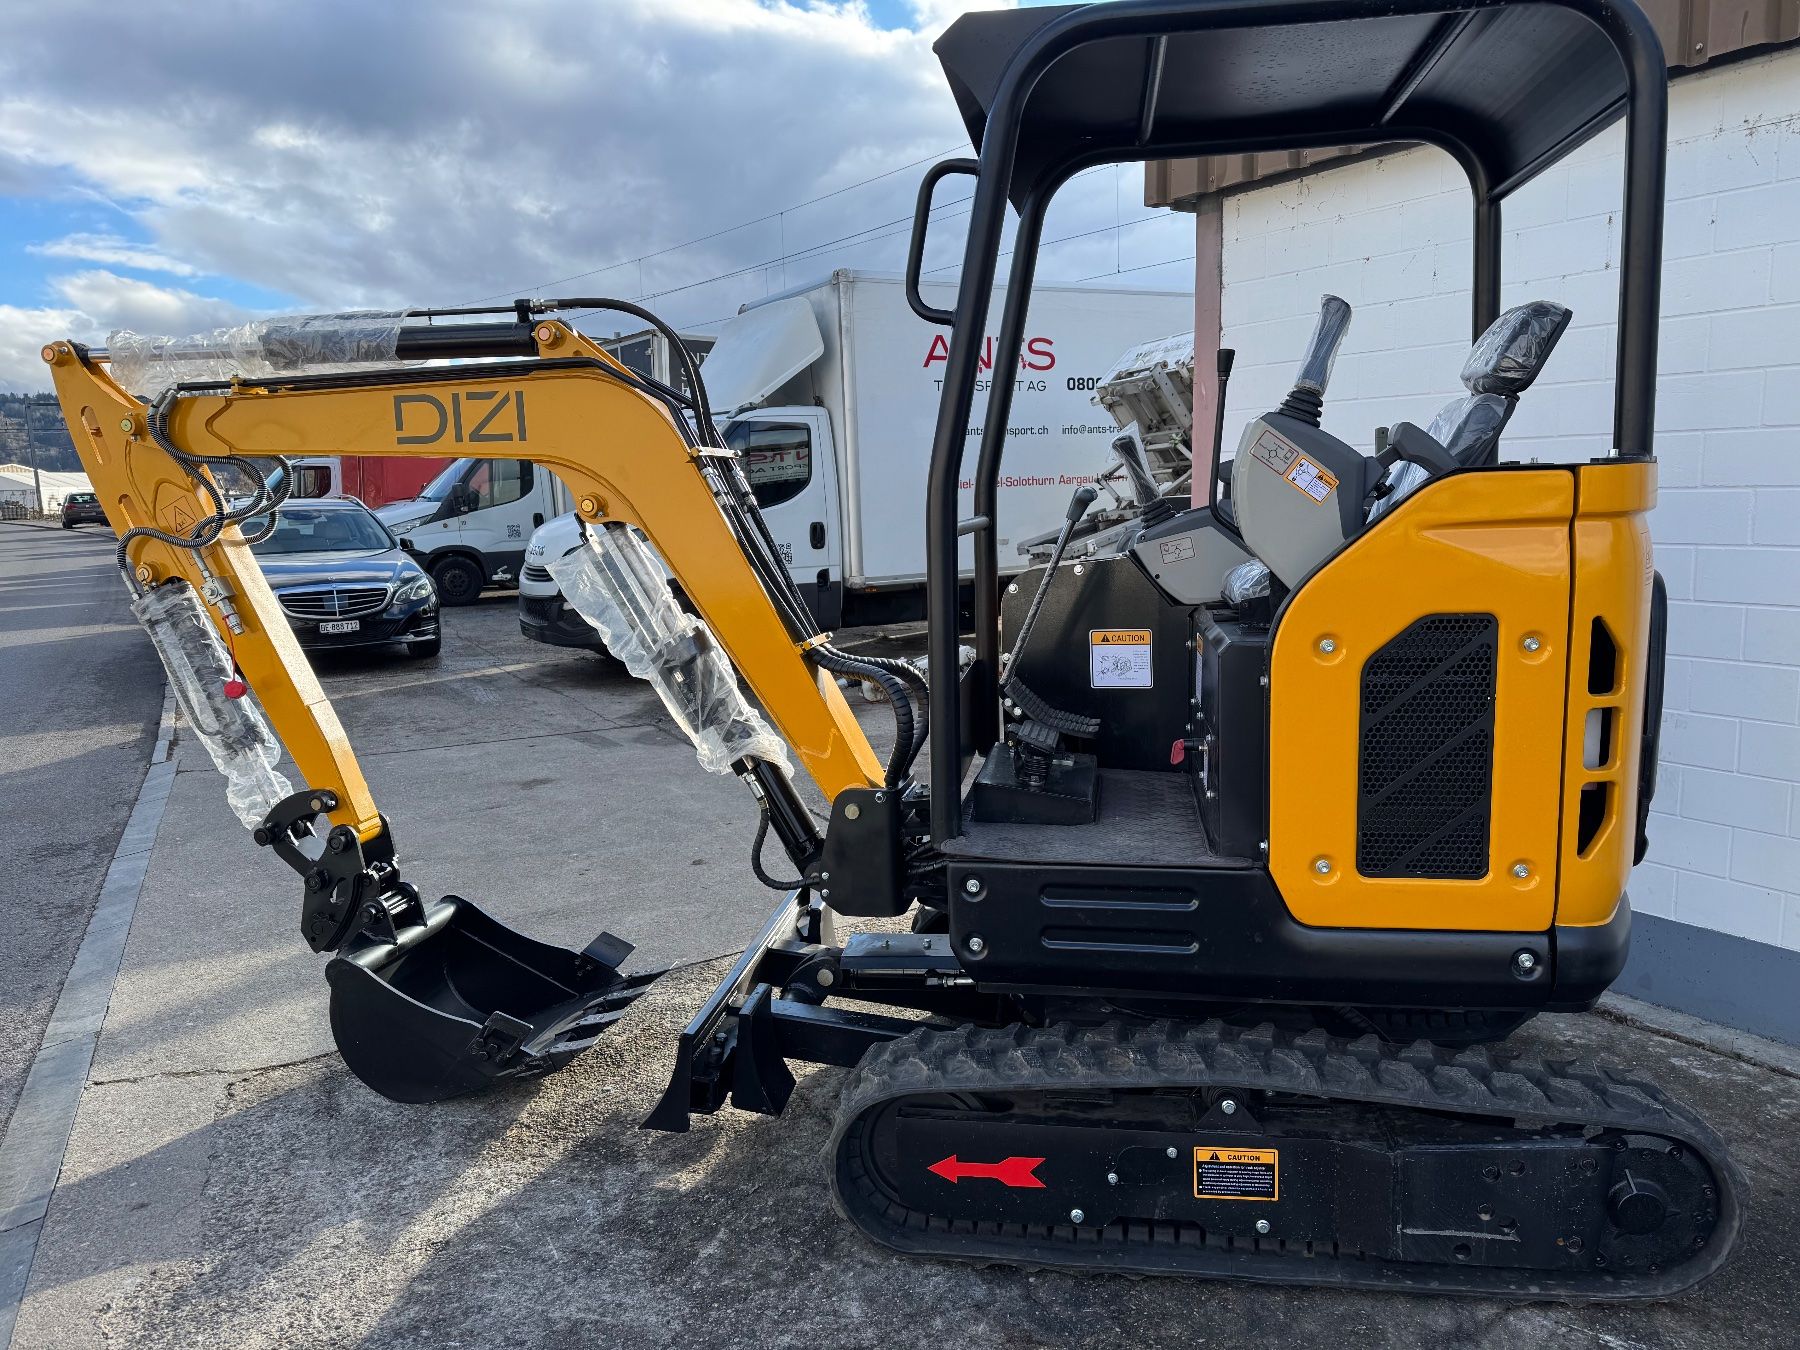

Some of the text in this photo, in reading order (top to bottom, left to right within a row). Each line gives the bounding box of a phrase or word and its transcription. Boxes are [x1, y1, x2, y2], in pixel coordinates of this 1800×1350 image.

[1027, 380, 1047, 392] AG
[393, 390, 527, 445] DIZI
[1111, 634, 1145, 642] CAUTION
